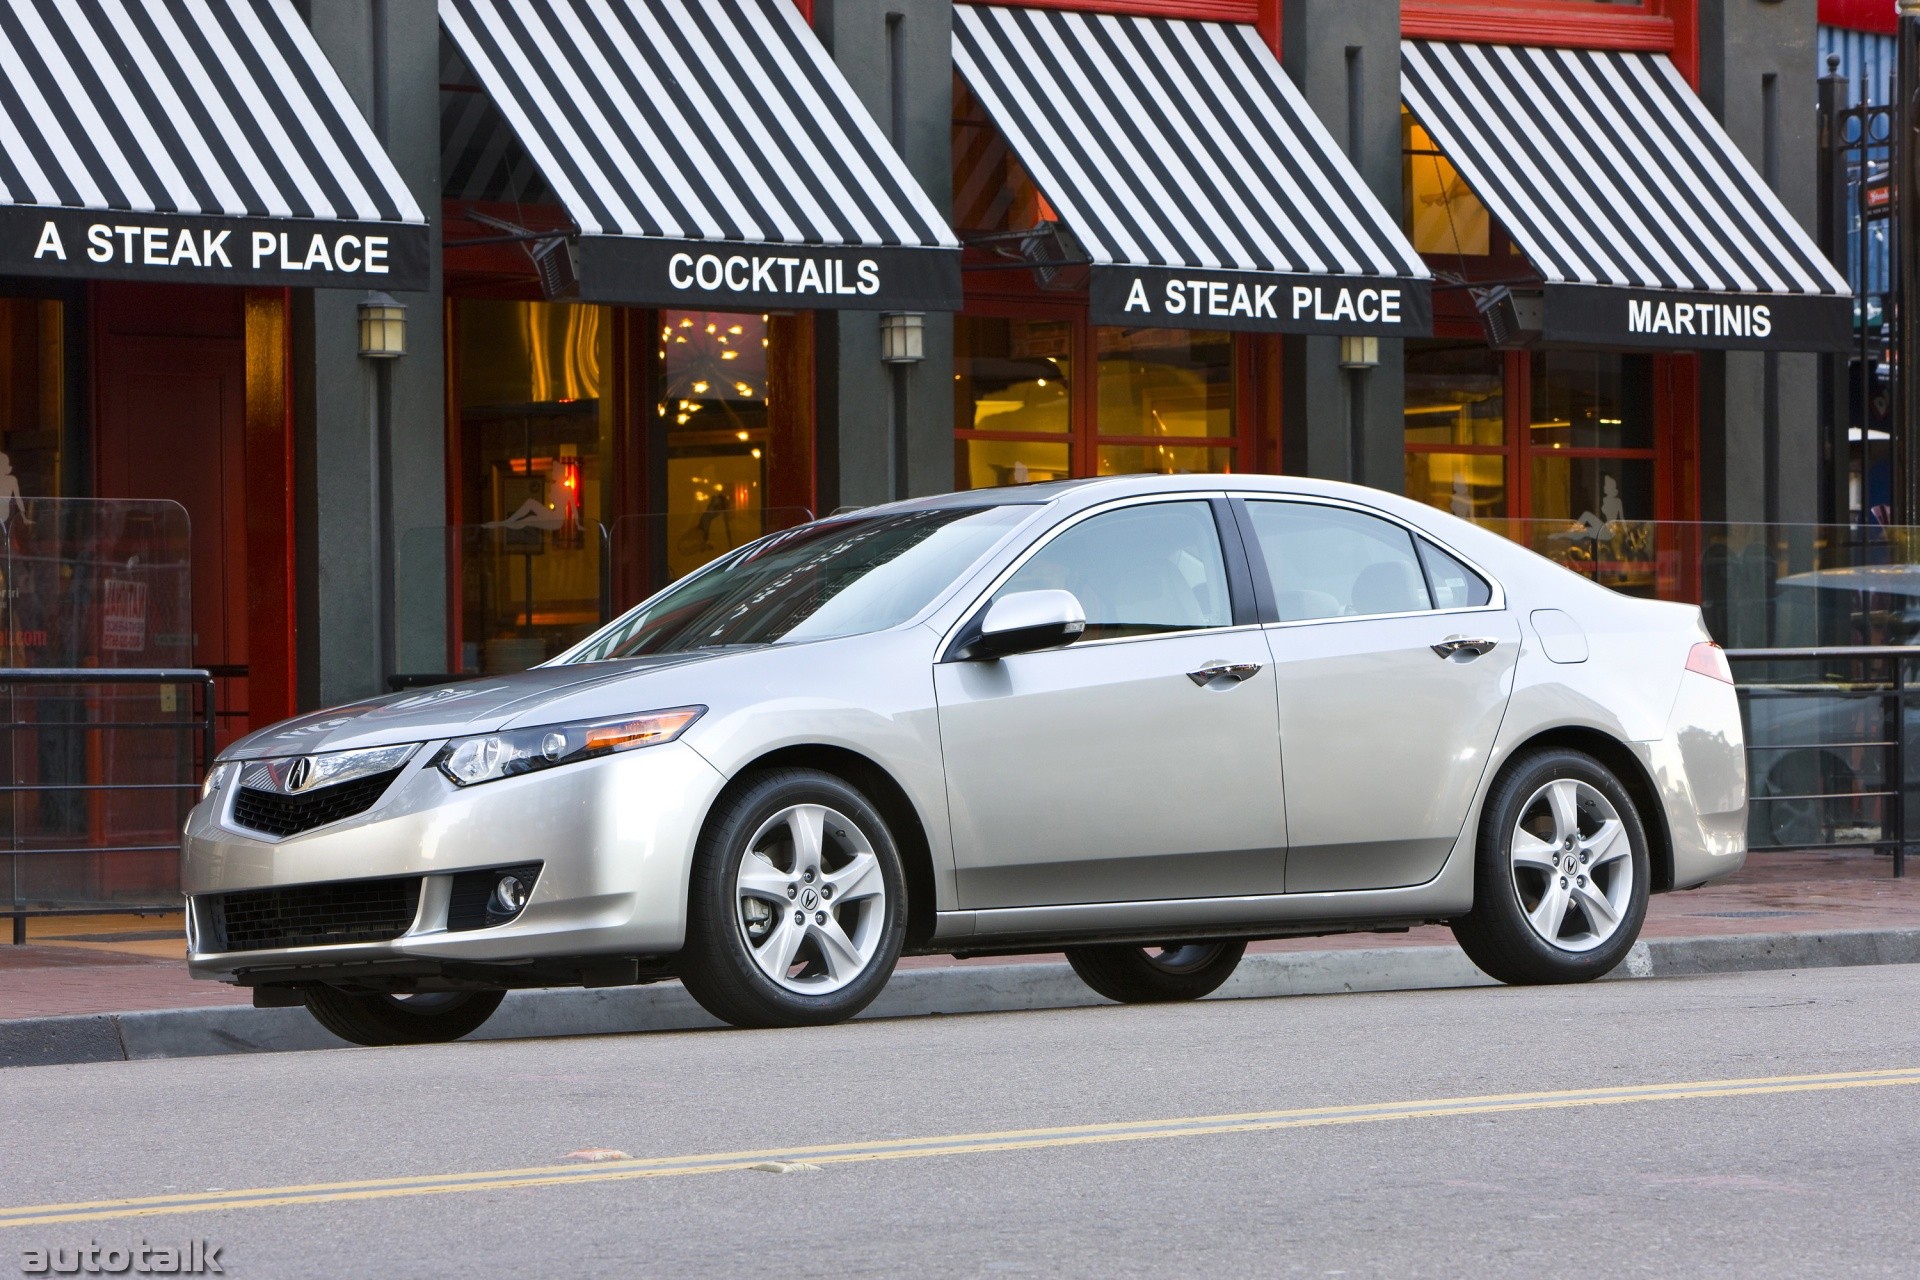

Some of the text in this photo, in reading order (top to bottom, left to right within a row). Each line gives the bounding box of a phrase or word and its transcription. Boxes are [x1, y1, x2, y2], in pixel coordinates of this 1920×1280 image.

[33, 221, 390, 274] A STEAK PLACE
[668, 252, 880, 295] COCKTAILS
[1124, 278, 1401, 323] A STEAK PLACE
[1628, 299, 1772, 338] MARTINIS
